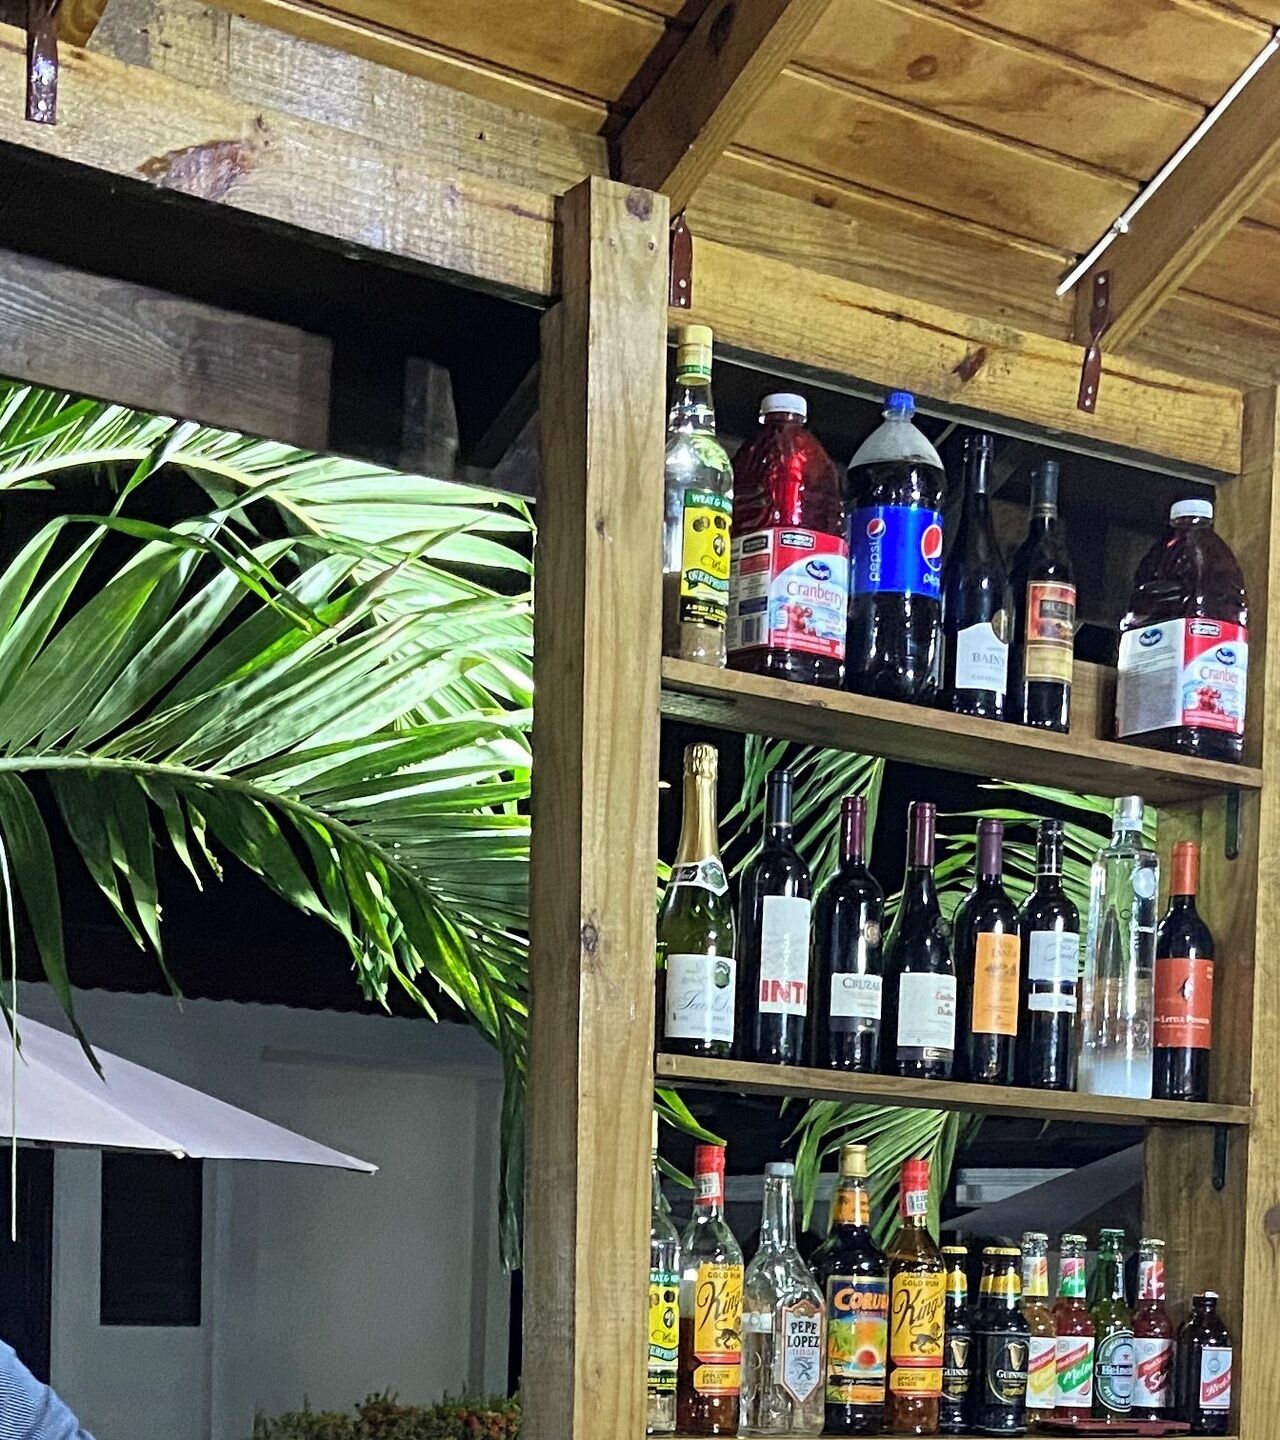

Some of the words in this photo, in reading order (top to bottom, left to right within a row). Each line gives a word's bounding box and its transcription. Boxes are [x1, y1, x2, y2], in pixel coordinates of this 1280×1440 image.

[869, 538, 882, 583] pepsi
[786, 579, 845, 612] Cranberry
[790, 1320, 818, 1336] PEPE
[786, 1335, 820, 1349] LOPEZ
